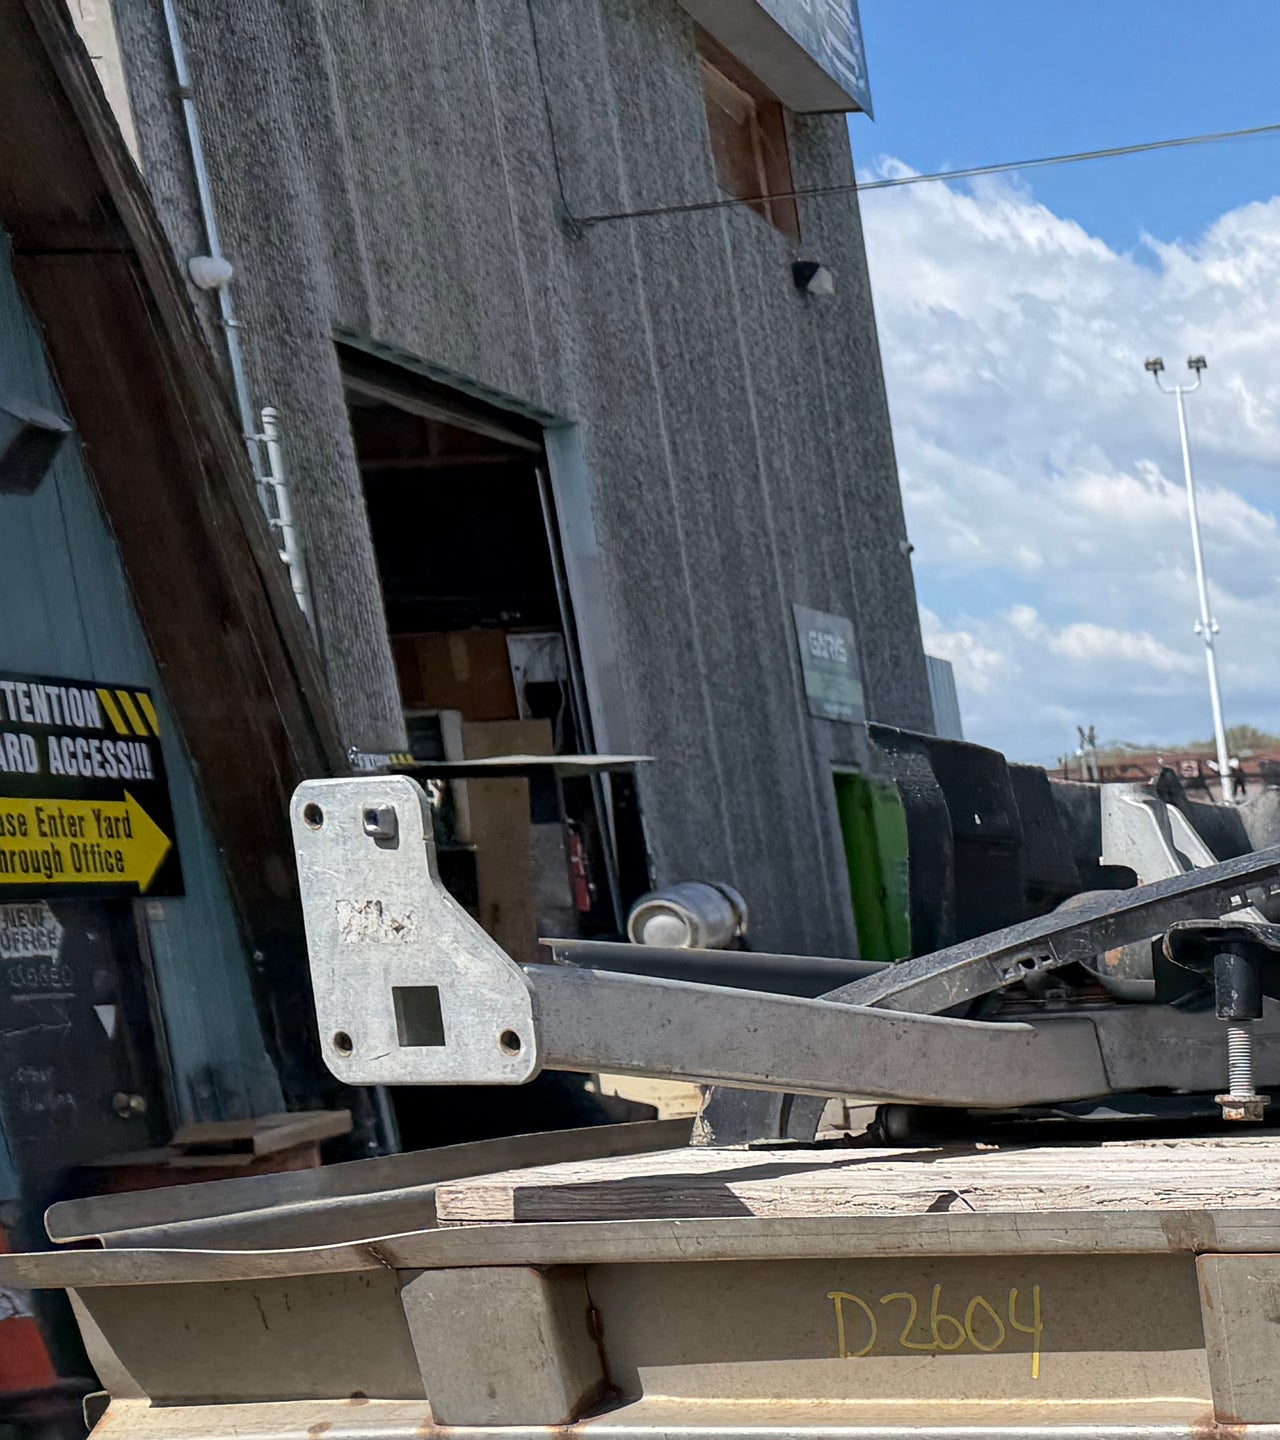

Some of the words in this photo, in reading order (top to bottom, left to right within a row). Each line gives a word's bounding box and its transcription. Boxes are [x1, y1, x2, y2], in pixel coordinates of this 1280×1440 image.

[0, 680, 104, 729] TENTION
[47, 735, 155, 780] ACCESS!!!
[34, 806, 86, 838] Enter
[92, 808, 134, 839] Yard
[71, 843, 125, 873] Office
